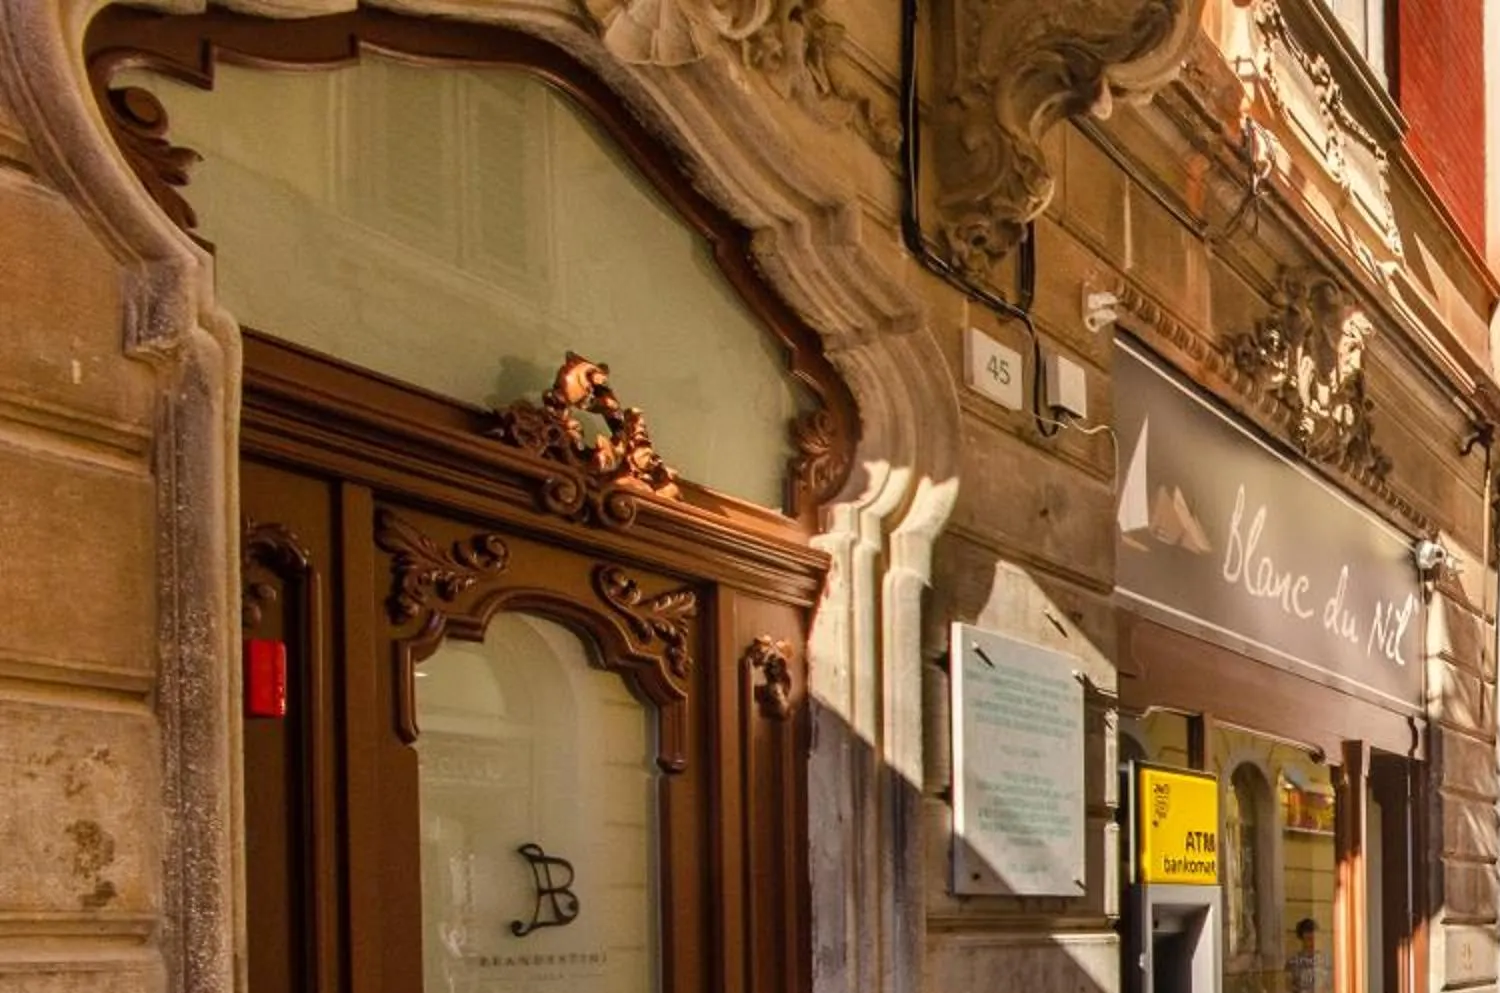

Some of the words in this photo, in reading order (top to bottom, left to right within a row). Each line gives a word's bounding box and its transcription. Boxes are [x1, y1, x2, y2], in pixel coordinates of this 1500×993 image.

[986, 354, 1011, 385] 45
[1223, 483, 1313, 620] Blanc
[1323, 565, 1358, 643] du
[1185, 830, 1215, 853] ATM
[1163, 853, 1216, 876] bankomat
